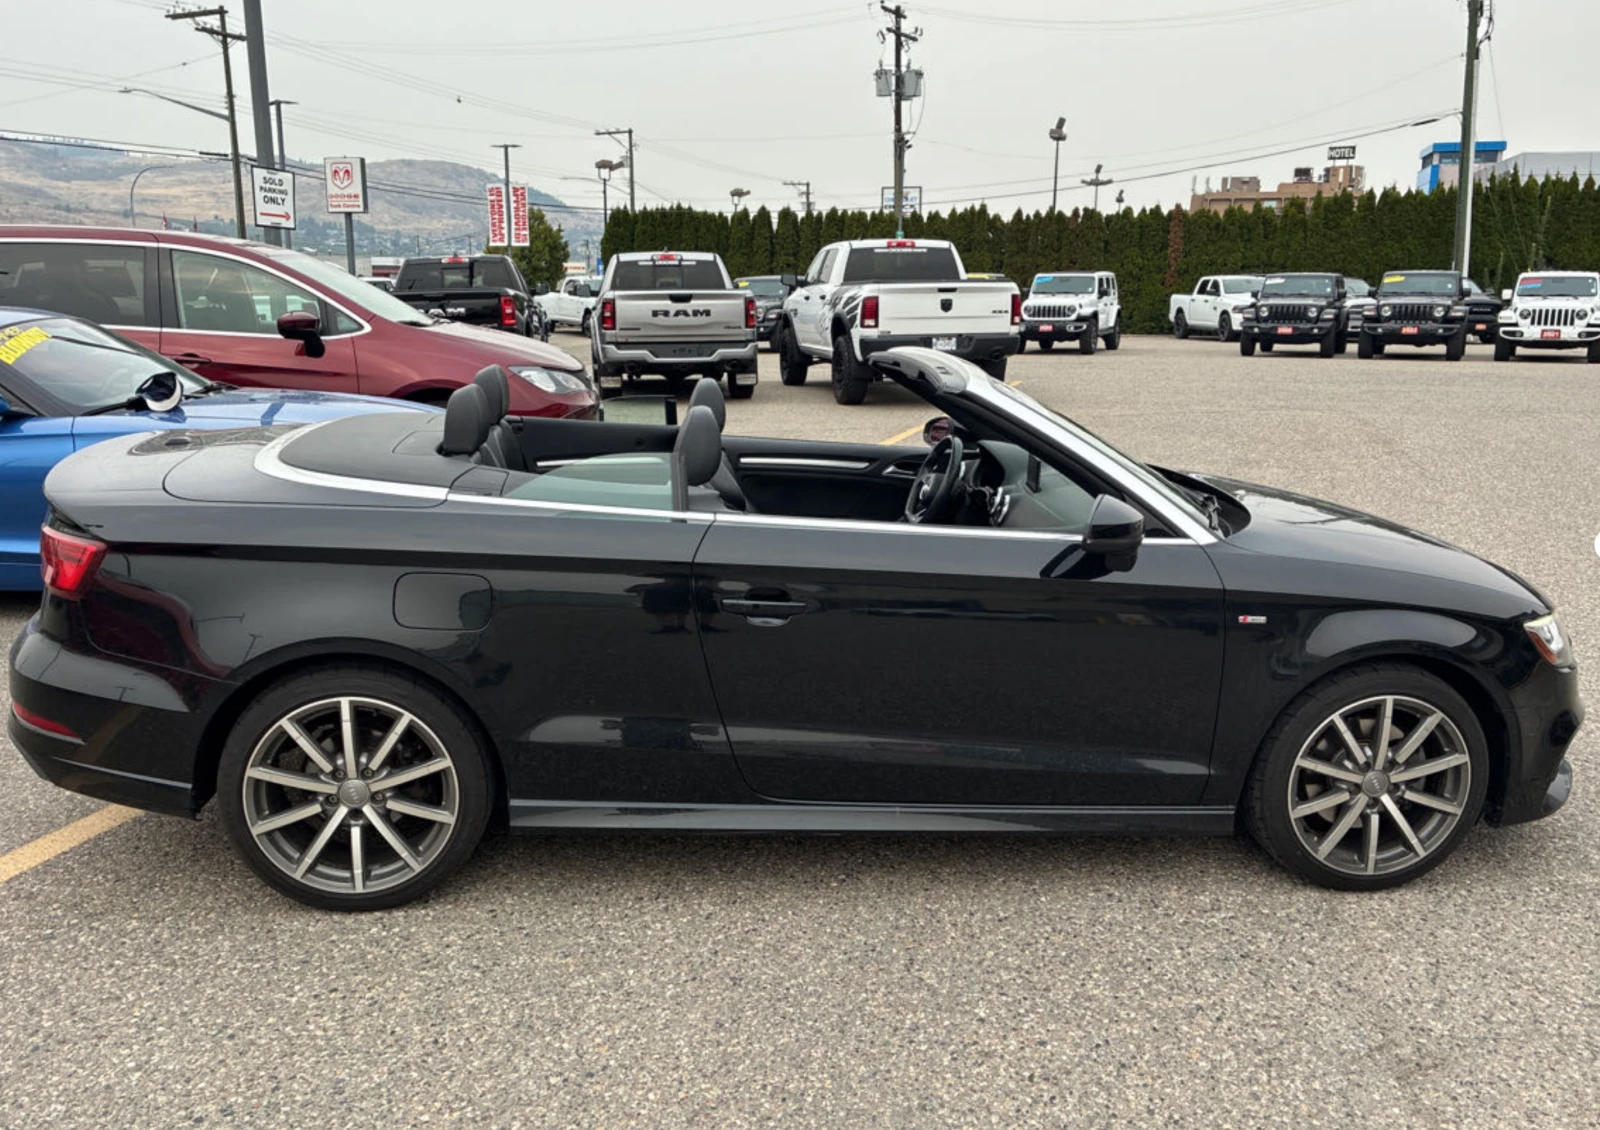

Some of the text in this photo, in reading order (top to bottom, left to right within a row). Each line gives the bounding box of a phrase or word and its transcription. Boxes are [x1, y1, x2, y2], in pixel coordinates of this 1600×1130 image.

[1328, 147, 1355, 158] HOTEL
[262, 175, 284, 187] SOLD
[259, 185, 288, 196] PARKING
[262, 194, 286, 206] ONLY
[494, 186, 505, 243] APPROVED!
[519, 186, 527, 231] EVERYONE
[488, 199, 498, 243] EVERYONE
[651, 308, 712, 319] RAM
